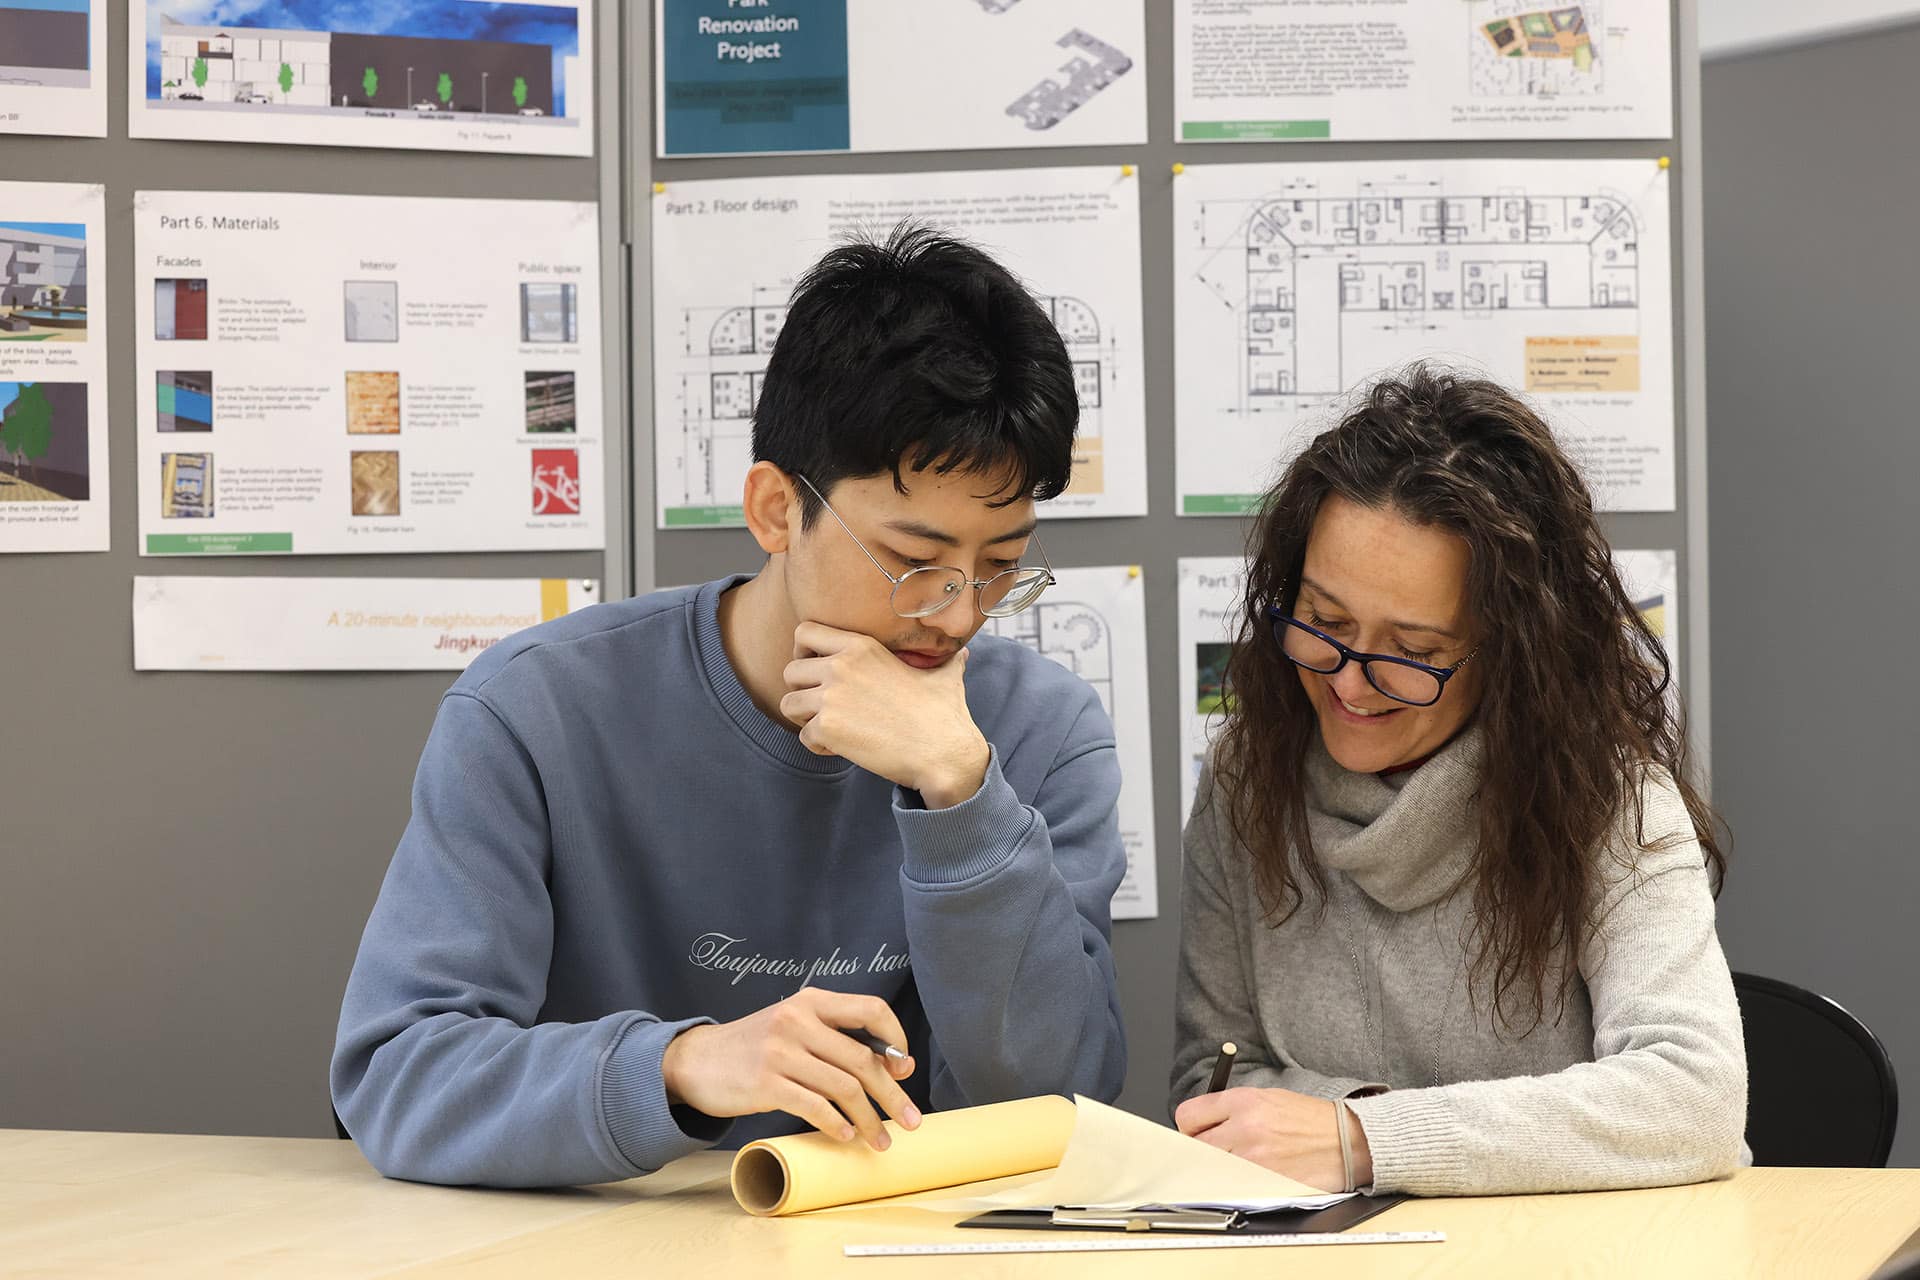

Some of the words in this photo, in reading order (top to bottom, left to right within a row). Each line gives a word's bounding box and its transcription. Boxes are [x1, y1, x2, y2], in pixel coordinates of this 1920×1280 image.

[698, 15, 799, 34] Renovation
[717, 42, 782, 63] Project
[665, 202, 693, 214] Part
[713, 200, 748, 213] Floor
[752, 199, 798, 213] design
[160, 216, 189, 229] Part
[194, 216, 208, 229] 6.
[212, 217, 280, 230] Materials
[156, 256, 203, 267] Facades
[360, 259, 397, 271] Interior
[518, 262, 549, 273] Public
[553, 265, 582, 275] space
[1199, 575, 1228, 588] Part
[328, 611, 339, 626] A
[343, 611, 418, 627] 20-minute
[422, 611, 537, 630] neighbourhood
[688, 932, 807, 985] Toujours
[798, 946, 862, 989] plus
[867, 943, 911, 973] hau
